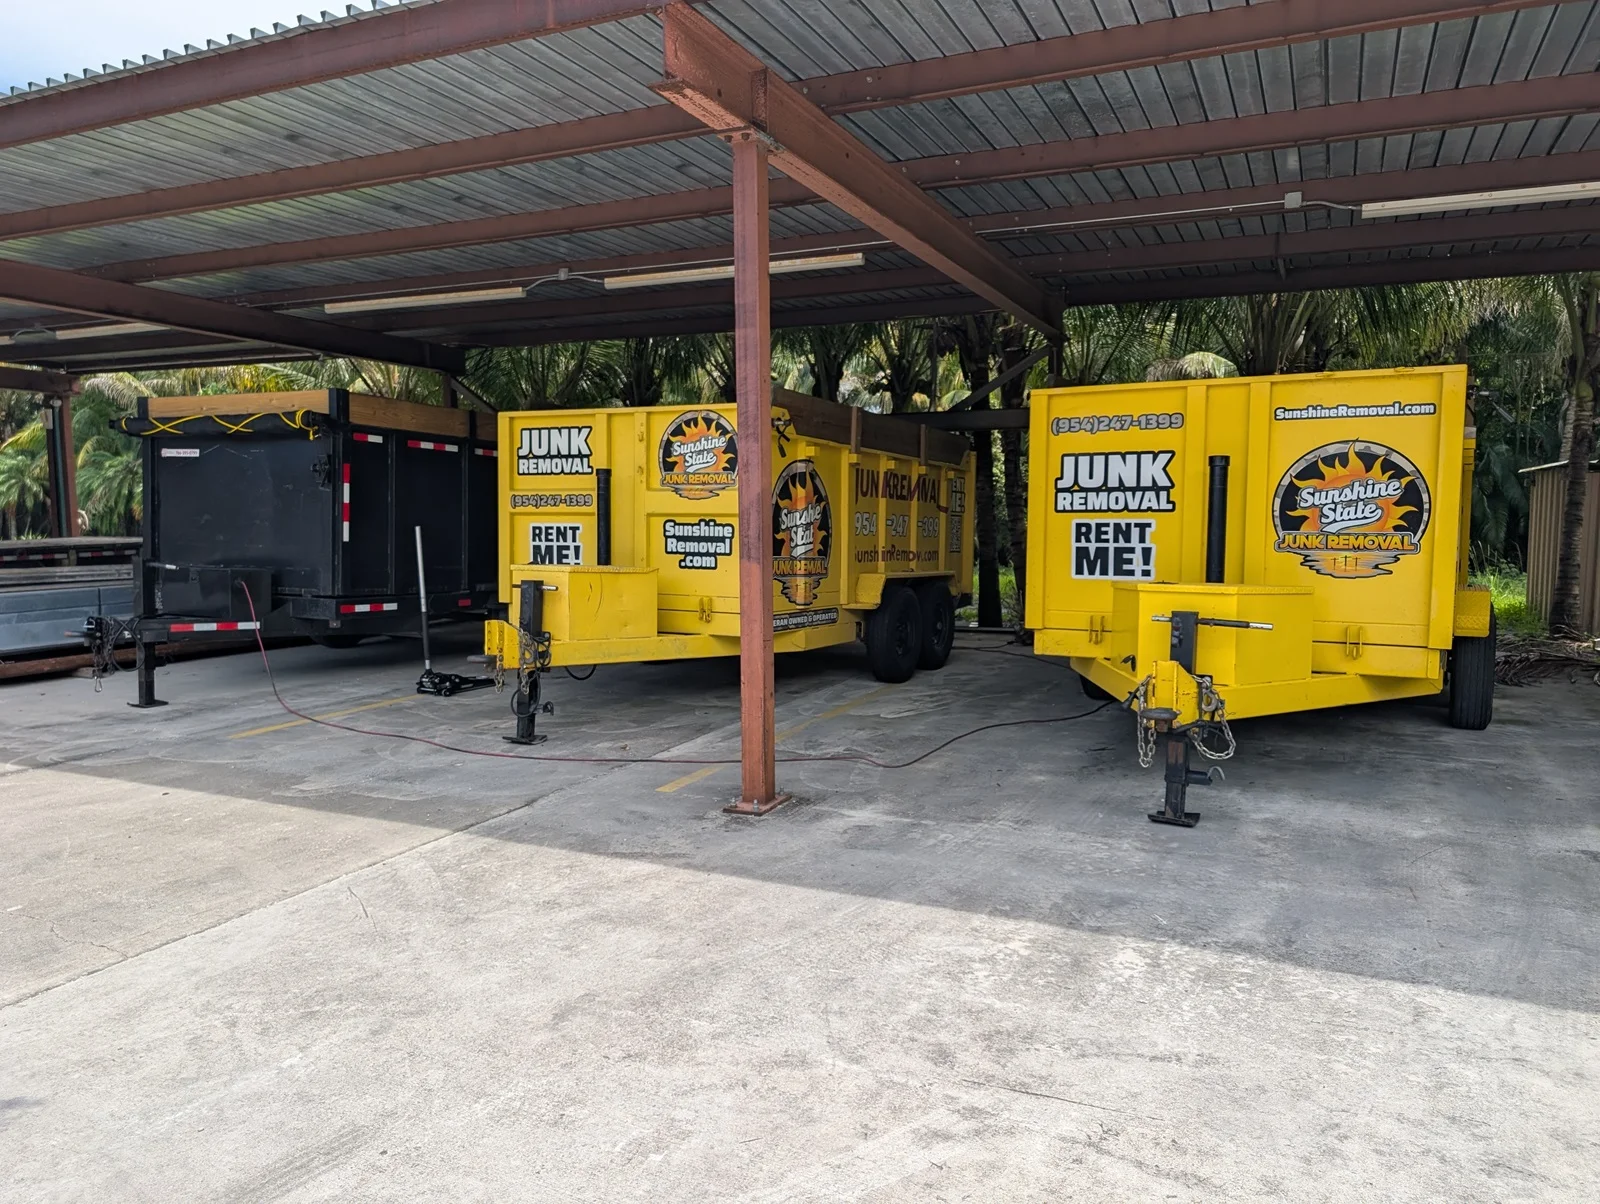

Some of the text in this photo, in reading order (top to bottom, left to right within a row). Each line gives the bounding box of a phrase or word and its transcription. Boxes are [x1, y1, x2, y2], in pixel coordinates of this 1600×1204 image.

[1275, 402, 1436, 420] SunshineRemoval.com
[1051, 413, 1184, 436] (954)247-1399
[518, 427, 592, 456] JUNK
[672, 435, 728, 457] Sunshine
[518, 457, 592, 475] REMOVAL
[684, 451, 717, 469] State
[661, 473, 736, 485] JUNK REMOVAL
[1056, 452, 1173, 489] JUNK
[511, 493, 593, 509] (954)247-1399
[1056, 490, 1173, 511] REMOVAL
[1299, 478, 1403, 508] Sunshine
[1321, 501, 1382, 525] State
[531, 525, 581, 543] RENT
[664, 521, 734, 537] Sunshine
[1074, 521, 1153, 544] RENT
[667, 537, 732, 555] Removal
[1279, 533, 1415, 551] JUNK REMOVAL
[532, 544, 581, 565] ME!
[680, 554, 717, 569] .com
[1074, 546, 1153, 578] ME!
[813, 612, 838, 622] OPERATED
